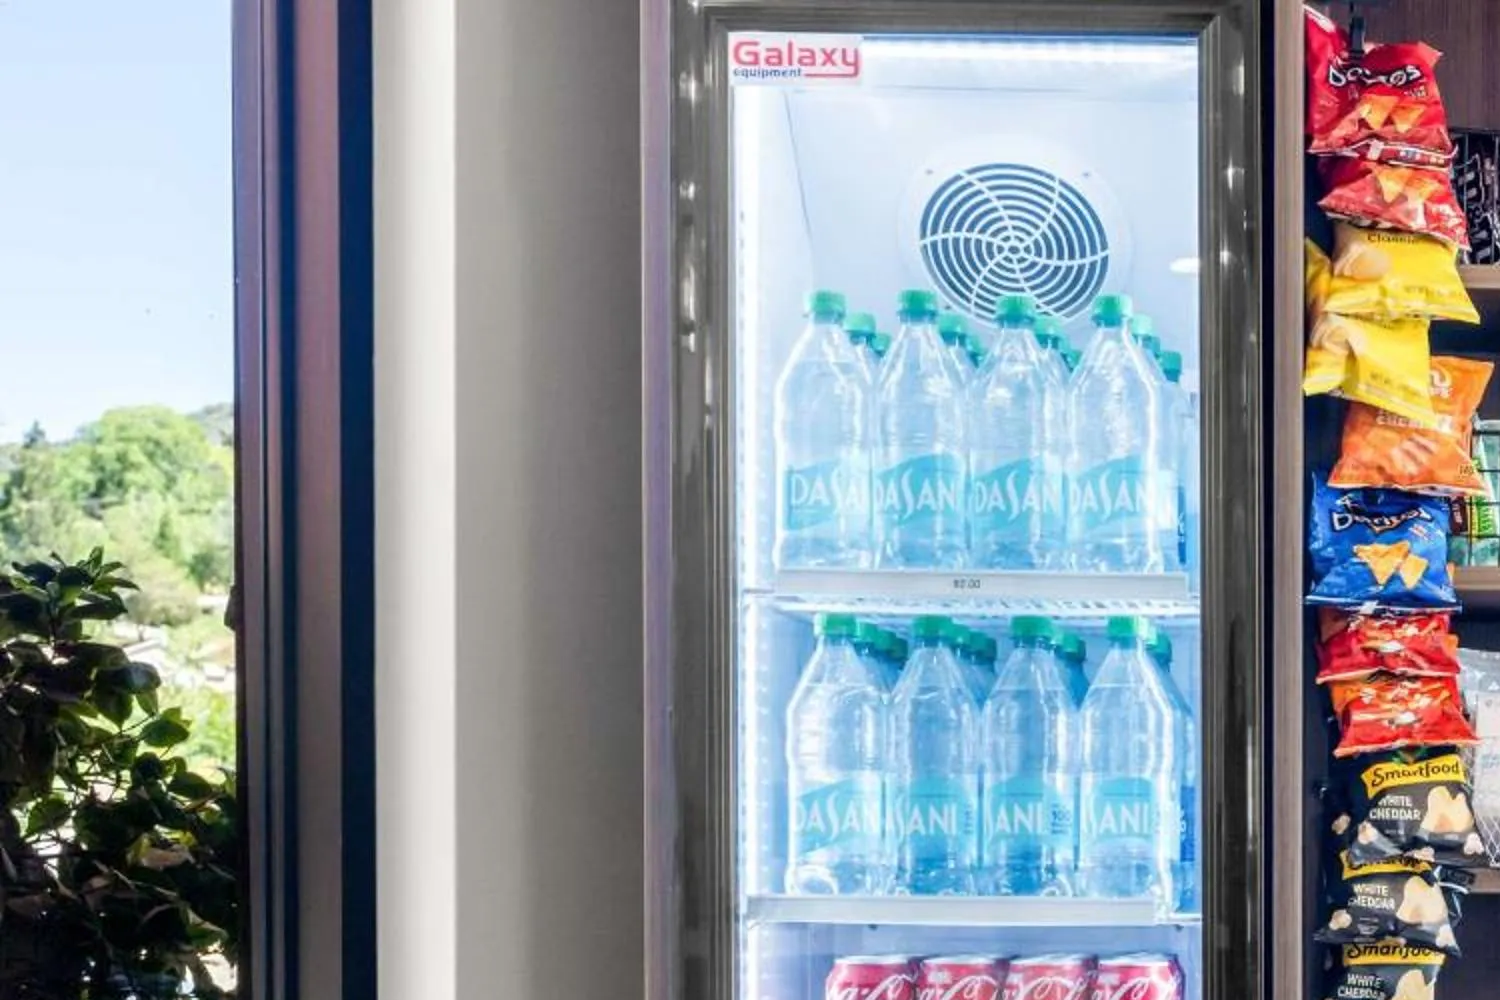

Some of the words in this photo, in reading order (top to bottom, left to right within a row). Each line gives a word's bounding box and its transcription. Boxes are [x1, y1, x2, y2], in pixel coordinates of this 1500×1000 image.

[733, 40, 860, 78] Galaxy
[733, 67, 802, 79] equipment
[1371, 761, 1460, 787] Smartfood
[1369, 807, 1422, 821] CHEDDAR
